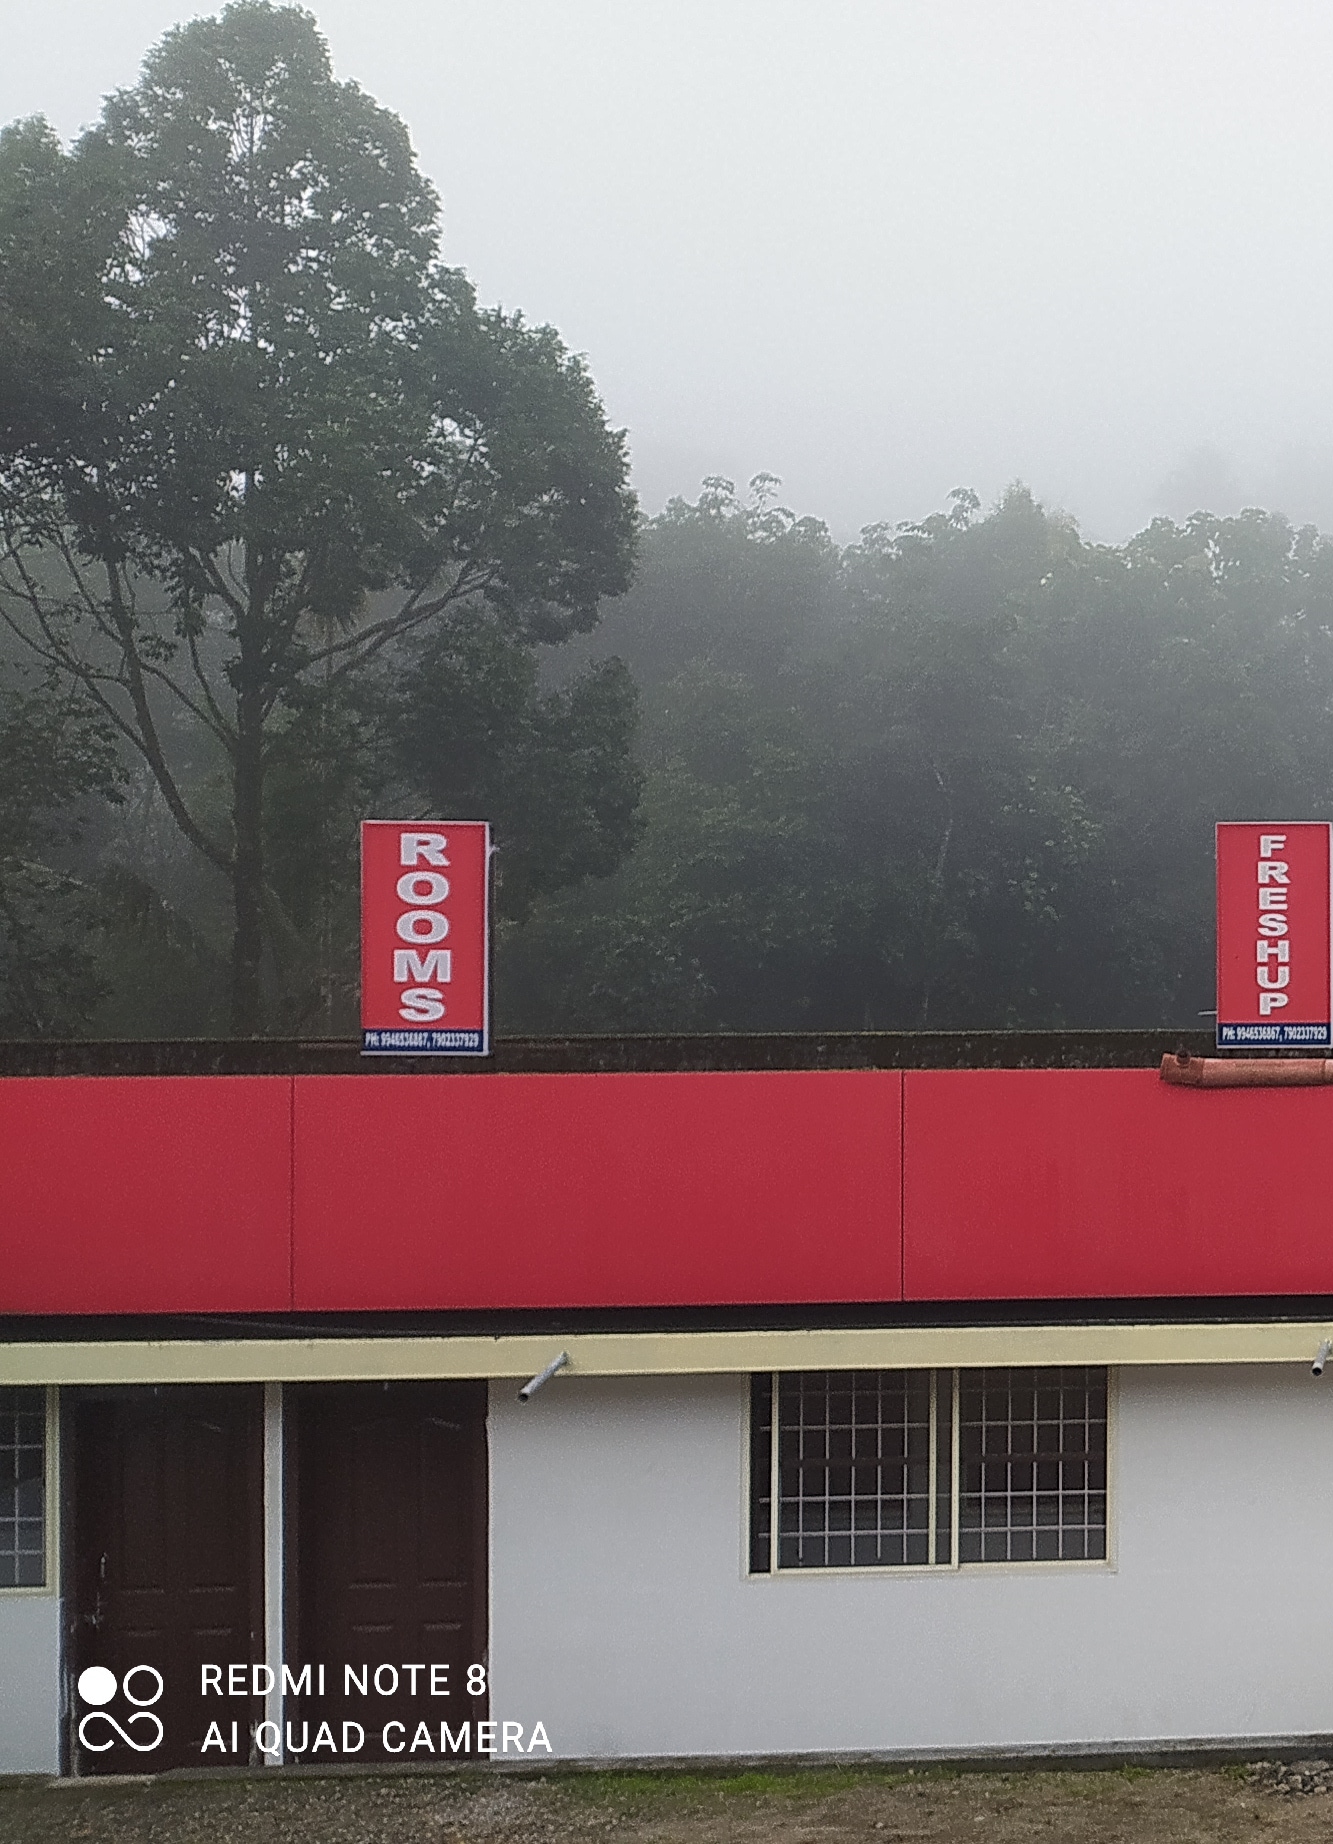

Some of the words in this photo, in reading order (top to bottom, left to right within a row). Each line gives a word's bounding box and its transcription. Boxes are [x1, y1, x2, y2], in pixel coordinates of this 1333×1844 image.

[393, 832, 453, 1023] ROOMS
[1256, 834, 1291, 1016] FRESHUP
[365, 1032, 379, 1046] PH:
[1222, 1026, 1235, 1040] PH:
